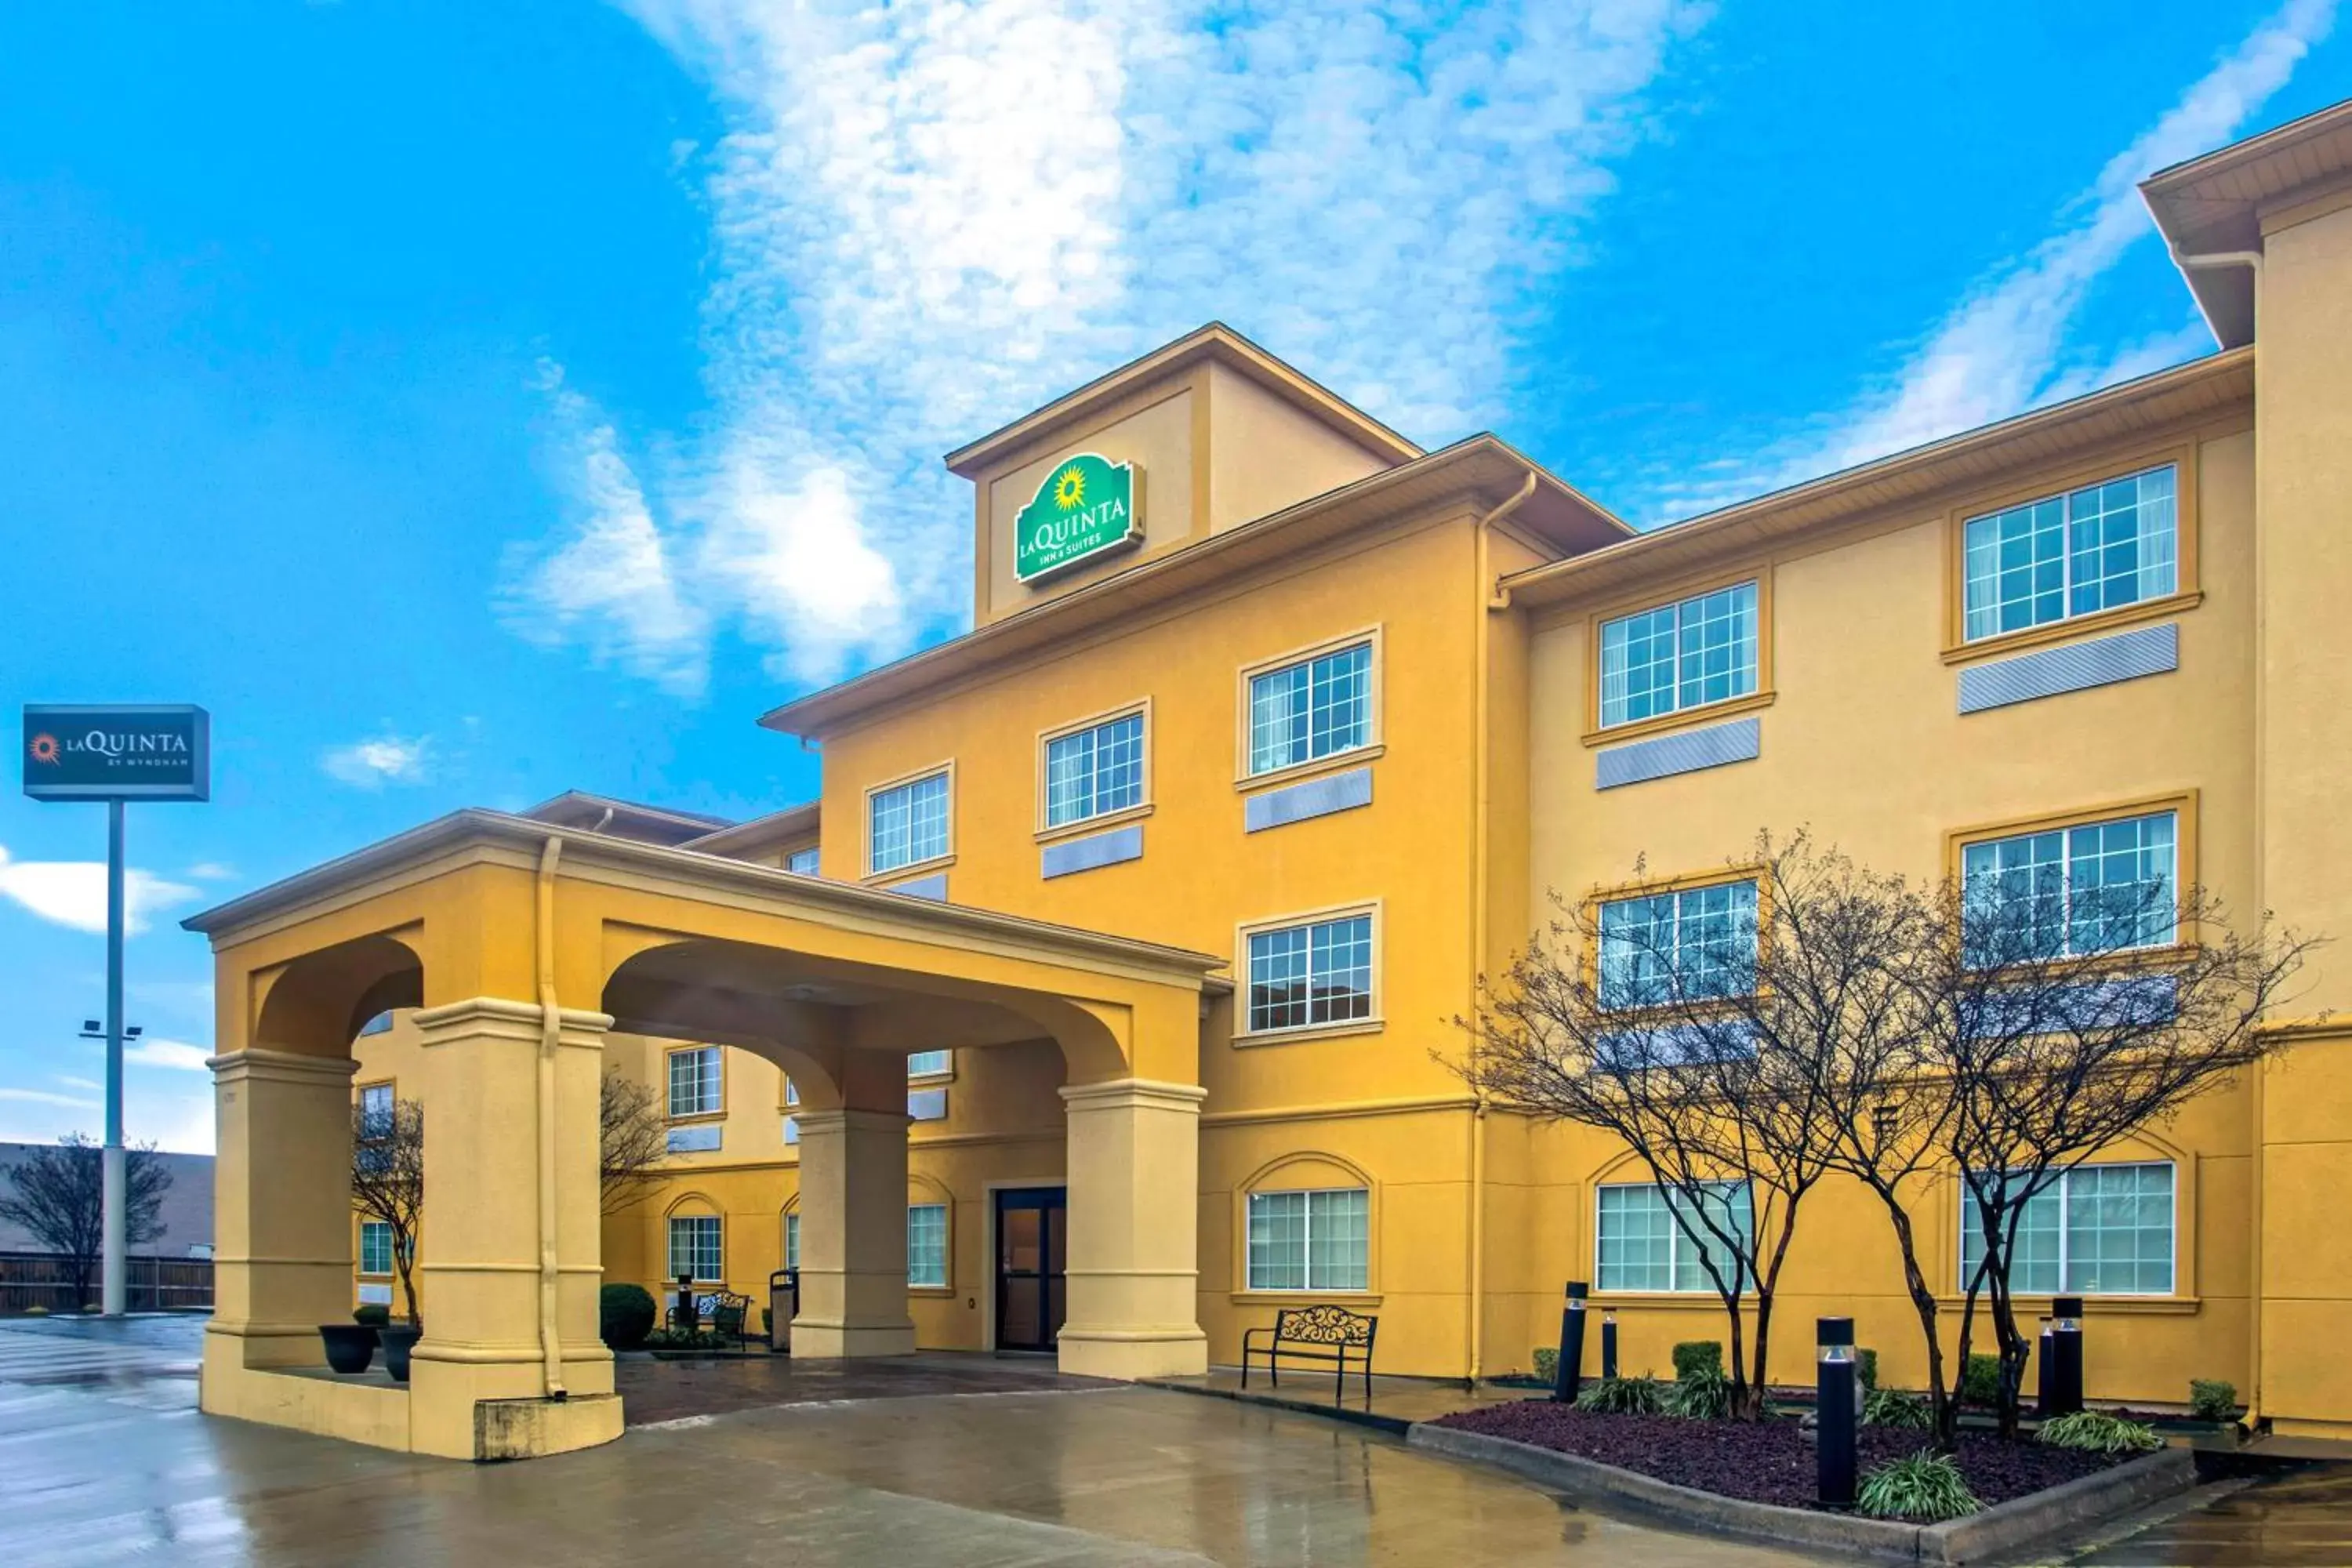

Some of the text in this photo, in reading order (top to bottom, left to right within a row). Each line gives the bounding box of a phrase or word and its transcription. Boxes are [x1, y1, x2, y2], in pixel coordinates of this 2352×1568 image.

[1035, 496, 1127, 550] QUINTA
[1040, 551, 1058, 565] INN
[1065, 532, 1102, 555] SUITES
[85, 730, 188, 757] QUINTA
